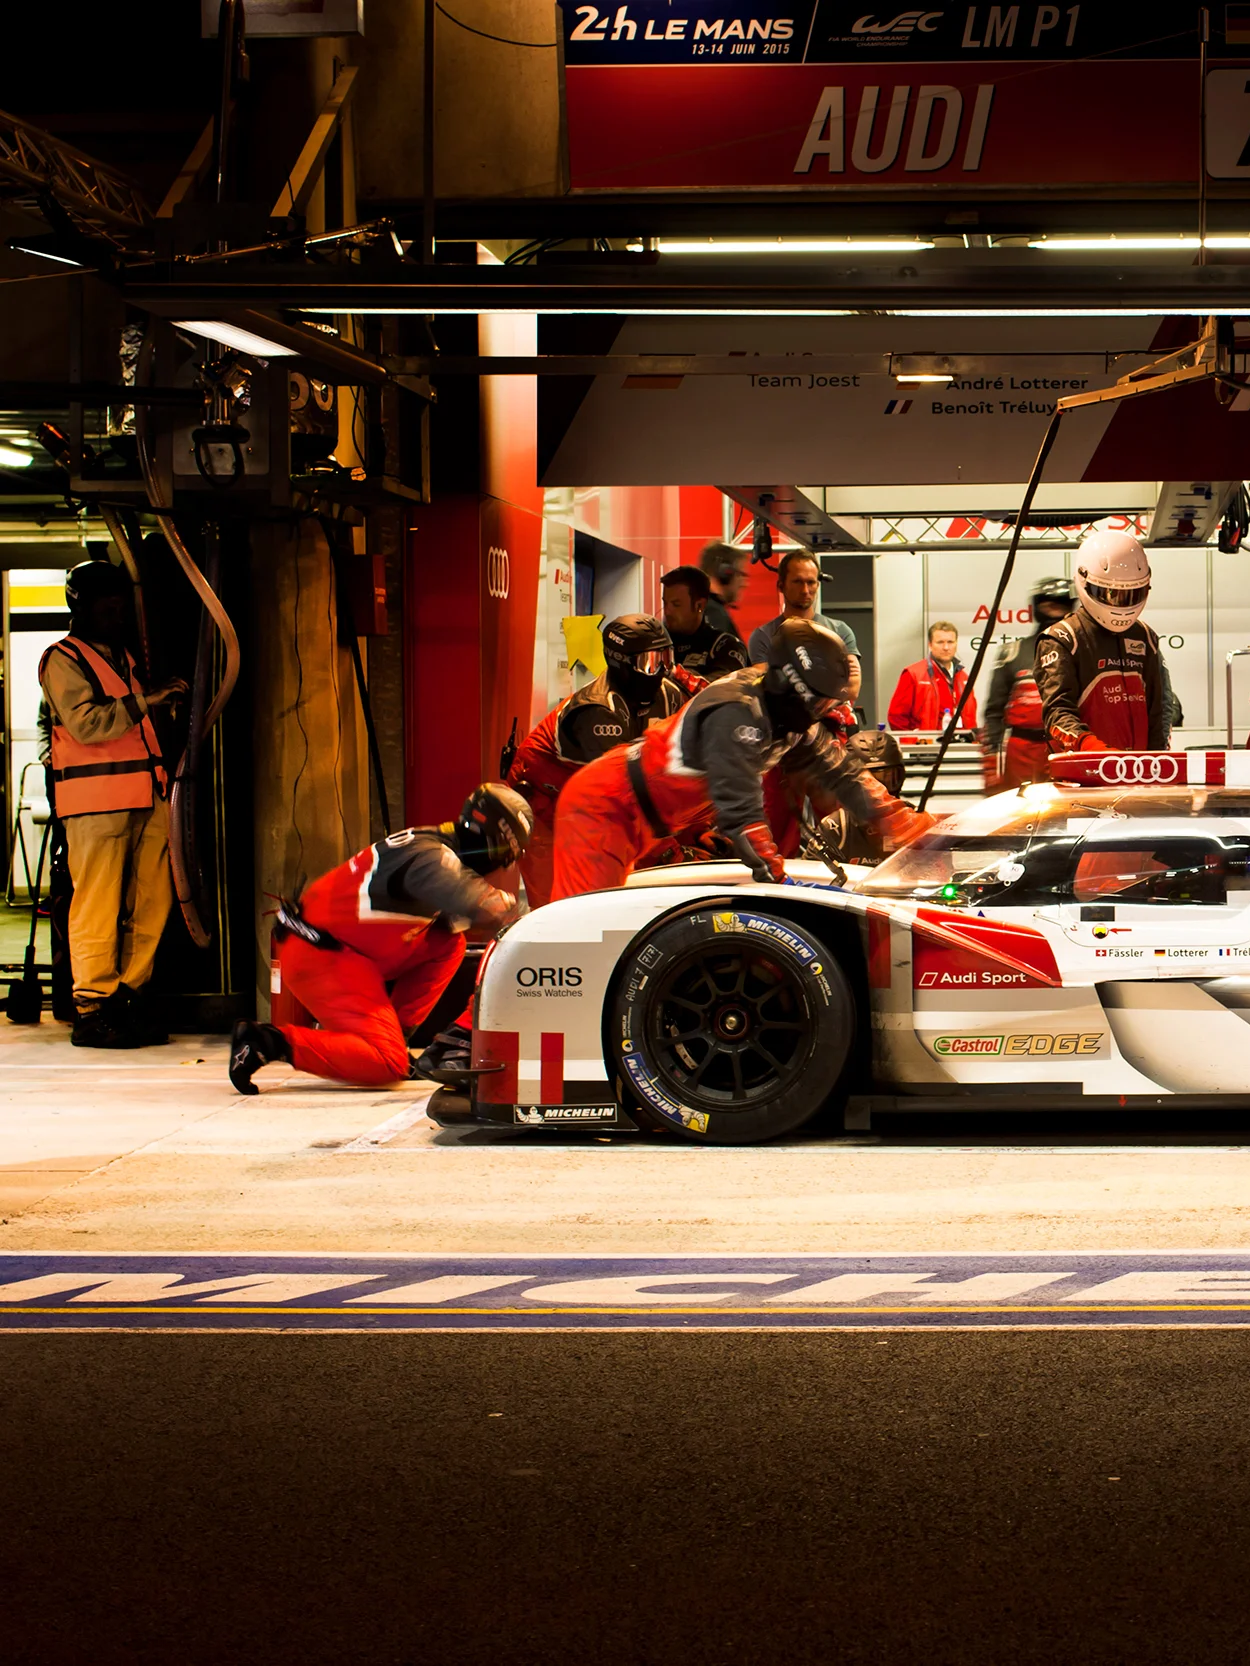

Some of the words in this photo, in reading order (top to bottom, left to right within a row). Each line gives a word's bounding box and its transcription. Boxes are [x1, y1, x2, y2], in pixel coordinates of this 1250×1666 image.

[570, 5, 638, 41] 24h
[644, 19, 688, 40] LE
[693, 19, 794, 40] MANS
[851, 11, 944, 33] WEC
[961, 5, 1020, 48] LM
[1030, 4, 1081, 48] P1
[692, 43, 723, 55] 13-14
[730, 43, 755, 55] JUIN
[762, 43, 790, 55] 2015
[793, 84, 995, 173] AUDI
[747, 374, 801, 387] Team
[808, 374, 860, 389] Joest
[946, 377, 1003, 390] André
[1010, 377, 1088, 390] Lotterer
[932, 401, 993, 414] Benoît
[971, 604, 1035, 624] Aud
[608, 631, 626, 647] uvex
[690, 914, 707, 926] FL
[747, 918, 812, 959] MICHELIN
[1109, 948, 1144, 957] Fässler
[1168, 948, 1209, 957] Lotterer
[516, 967, 583, 987] ORIS
[940, 972, 977, 984] Audi
[981, 972, 1027, 986] Sport
[516, 989, 542, 997] Swiss
[544, 989, 583, 998] Watches
[951, 1038, 998, 1053] Castrol
[1004, 1033, 1104, 1055] EDGE
[626, 1058, 678, 1115] MICHELIN
[544, 1107, 614, 1118] MICHELIN
